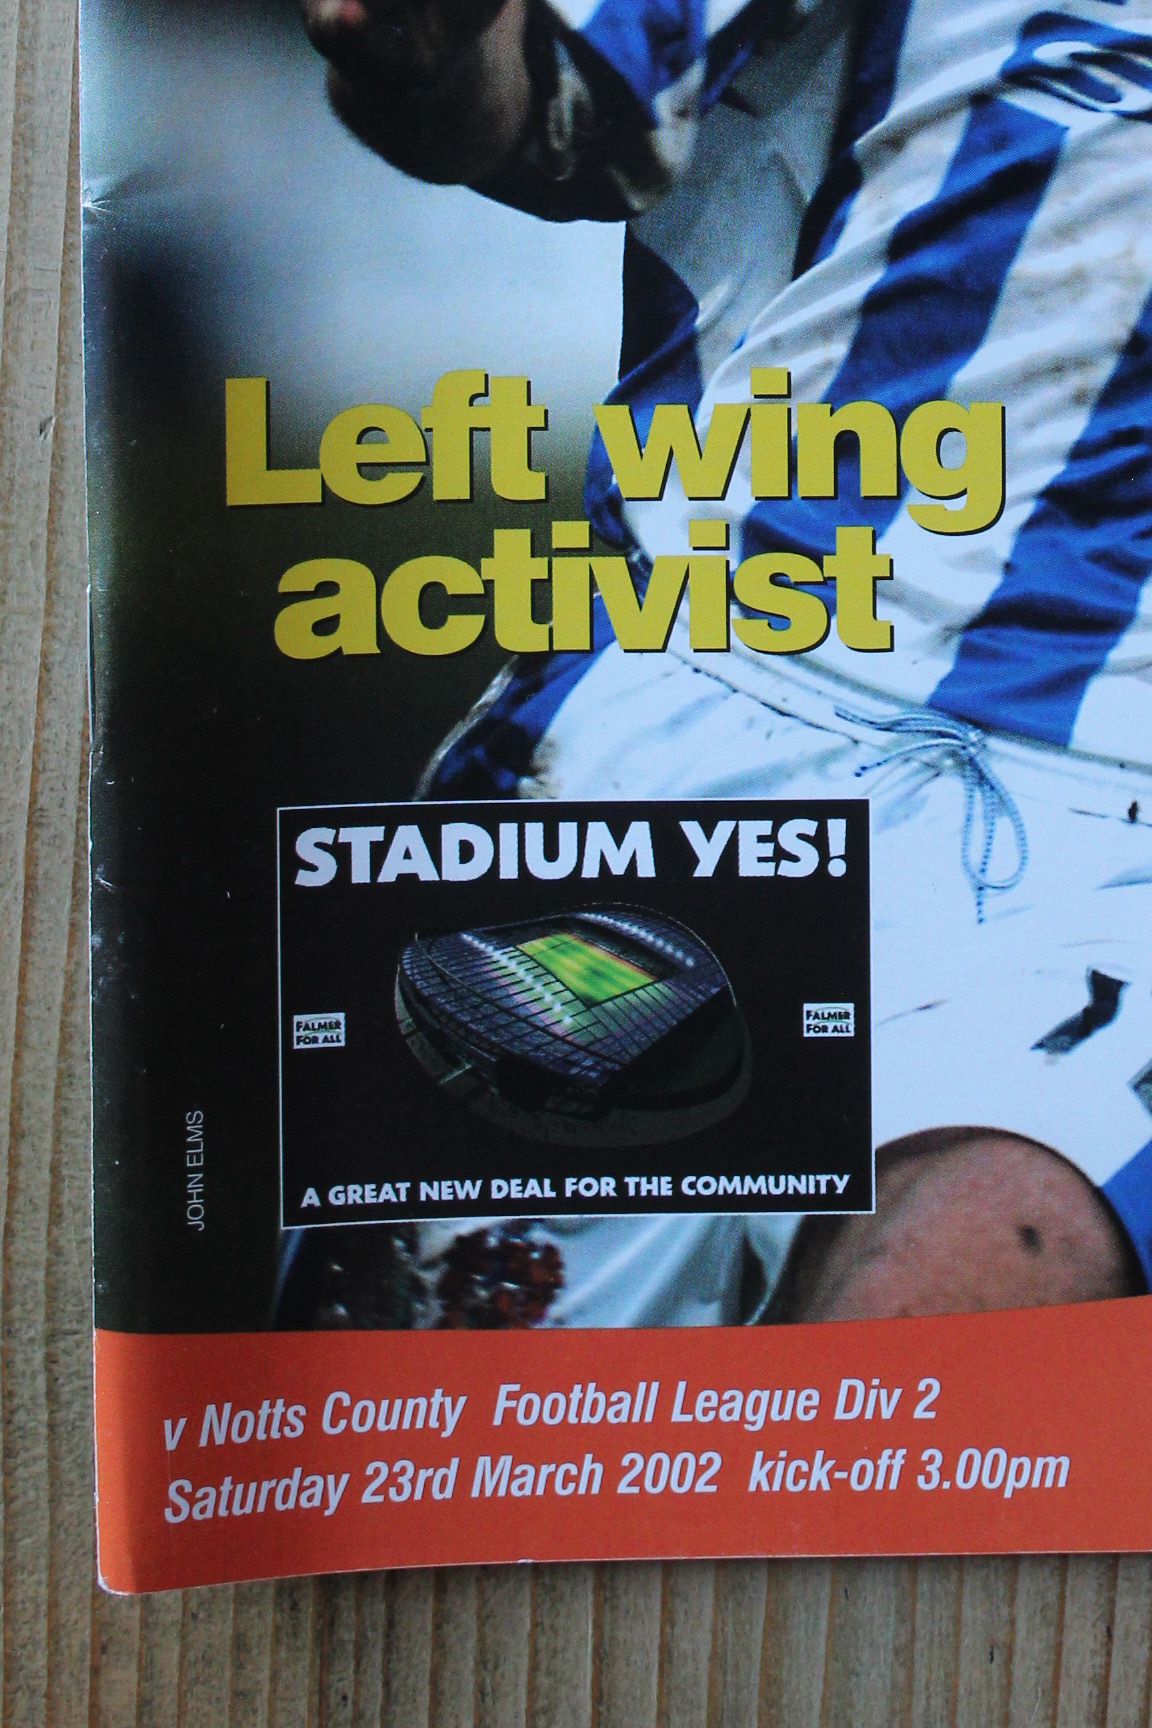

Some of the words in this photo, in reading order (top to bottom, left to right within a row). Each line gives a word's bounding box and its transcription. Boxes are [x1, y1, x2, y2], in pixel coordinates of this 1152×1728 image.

[225, 369, 546, 506] Left
[592, 367, 1003, 535] wing
[274, 519, 891, 659] activist
[294, 820, 657, 887] STADIUM
[679, 818, 847, 878] YES!
[296, 1035, 319, 1045] FOR
[322, 1034, 342, 1044] ALL
[806, 1023, 829, 1034] FOR
[831, 1024, 851, 1034] ALL
[185, 1110, 204, 1167] ELMS
[186, 1173, 205, 1232] JOHN
[300, 1187, 321, 1209] A
[328, 1181, 411, 1206] GREAT
[419, 1179, 483, 1202] NEW
[490, 1178, 557, 1200] DEAL
[564, 1176, 618, 1198] FOR
[623, 1176, 673, 1197] THE
[680, 1174, 851, 1196] COMMUNITY
[163, 1417, 188, 1451] v
[198, 1398, 307, 1447] Notts
[321, 1388, 468, 1438] County
[492, 1381, 660, 1426] Football
[670, 1380, 820, 1429] League
[833, 1378, 903, 1420] Div
[913, 1377, 941, 1419] 2
[164, 1466, 351, 1524] Saturday
[361, 1456, 460, 1504] 23rd
[470, 1453, 604, 1498] March
[616, 1450, 722, 1495] 2002
[748, 1448, 908, 1493] kick-off
[916, 1447, 1071, 1499] 3.00pm
